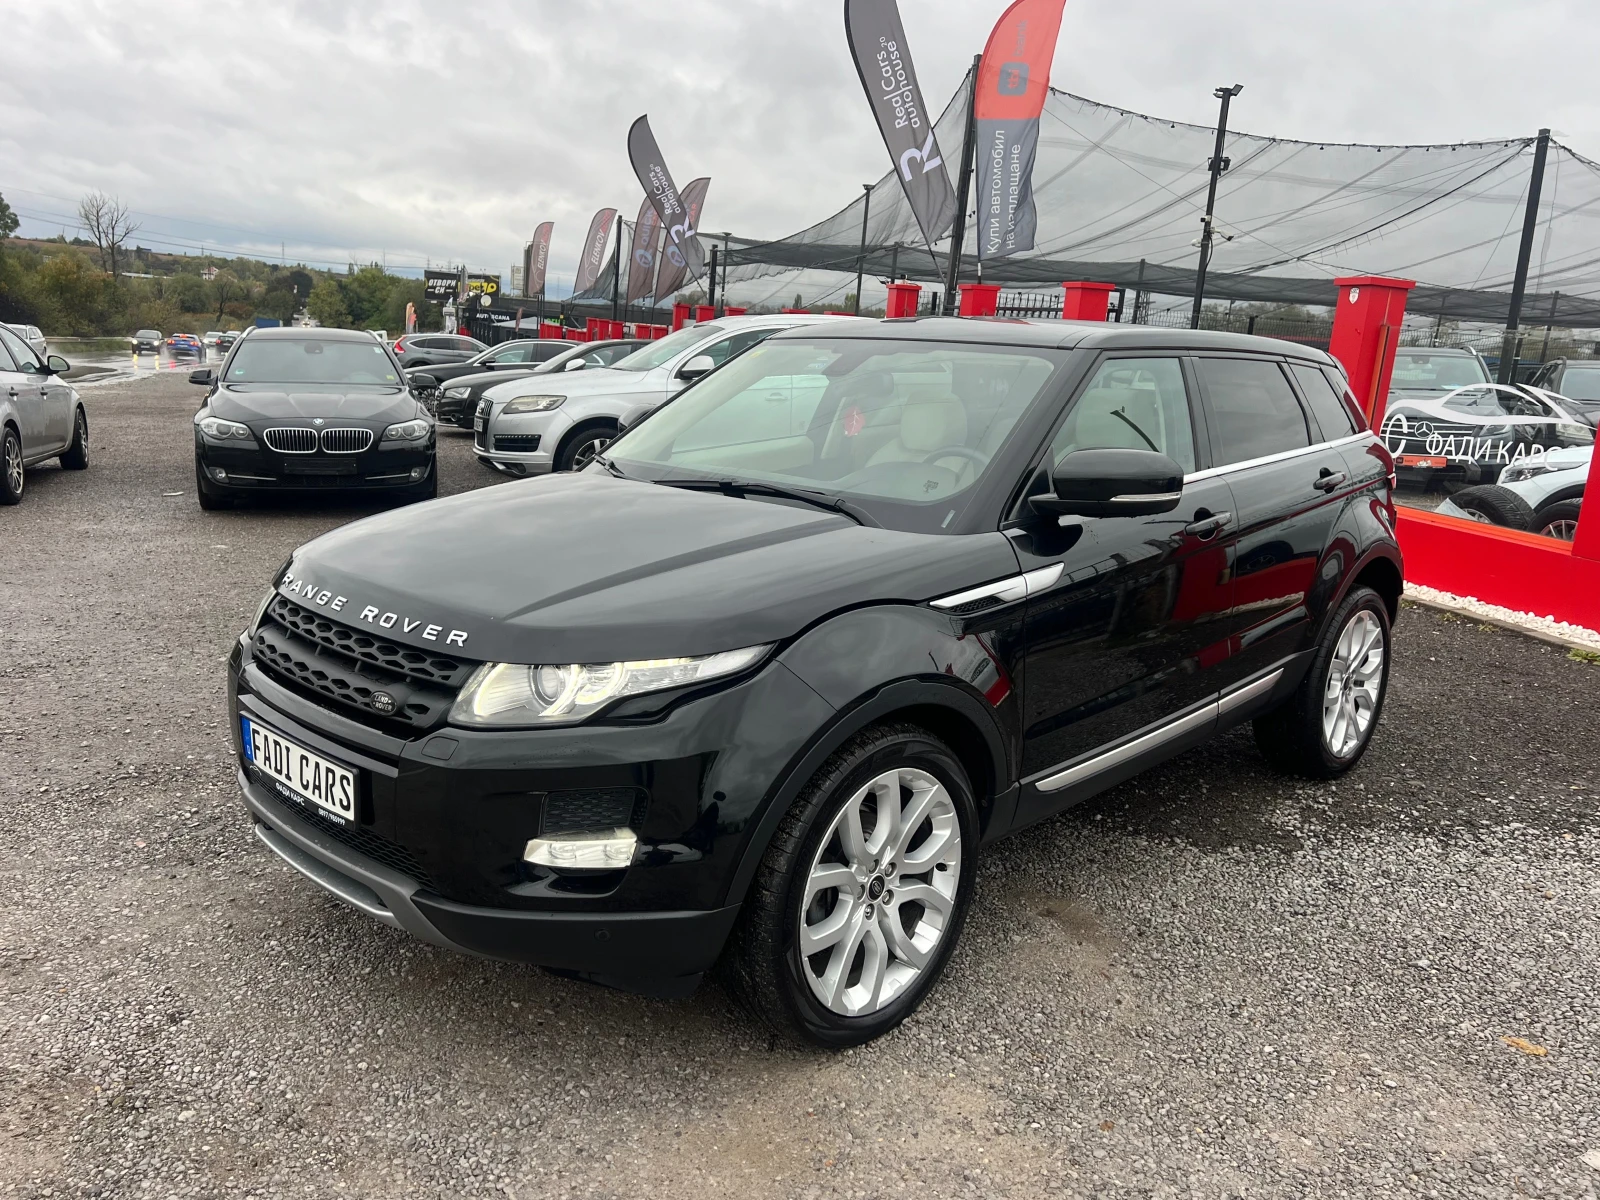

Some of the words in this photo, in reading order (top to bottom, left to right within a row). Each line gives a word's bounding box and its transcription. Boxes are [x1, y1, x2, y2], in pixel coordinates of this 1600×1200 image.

[1011, 19, 1028, 57] bank
[877, 50, 896, 91] Cars
[887, 41, 920, 128] autohouse
[884, 91, 908, 128] Real
[649, 171, 663, 194] Cars
[654, 165, 681, 213] autohouse
[991, 130, 1005, 214] автомобил
[656, 192, 674, 214] Real
[987, 218, 1002, 254] Купи
[1005, 231, 1016, 249] на
[428, 278, 457, 287] ОТВОРИ
[1426, 432, 1492, 464] ФАДИ
[1496, 440, 1563, 471] КАРС
[282, 573, 348, 612] RANGE
[359, 605, 469, 647] ROVER
[252, 727, 293, 782] FADI
[300, 753, 351, 812] CARS
